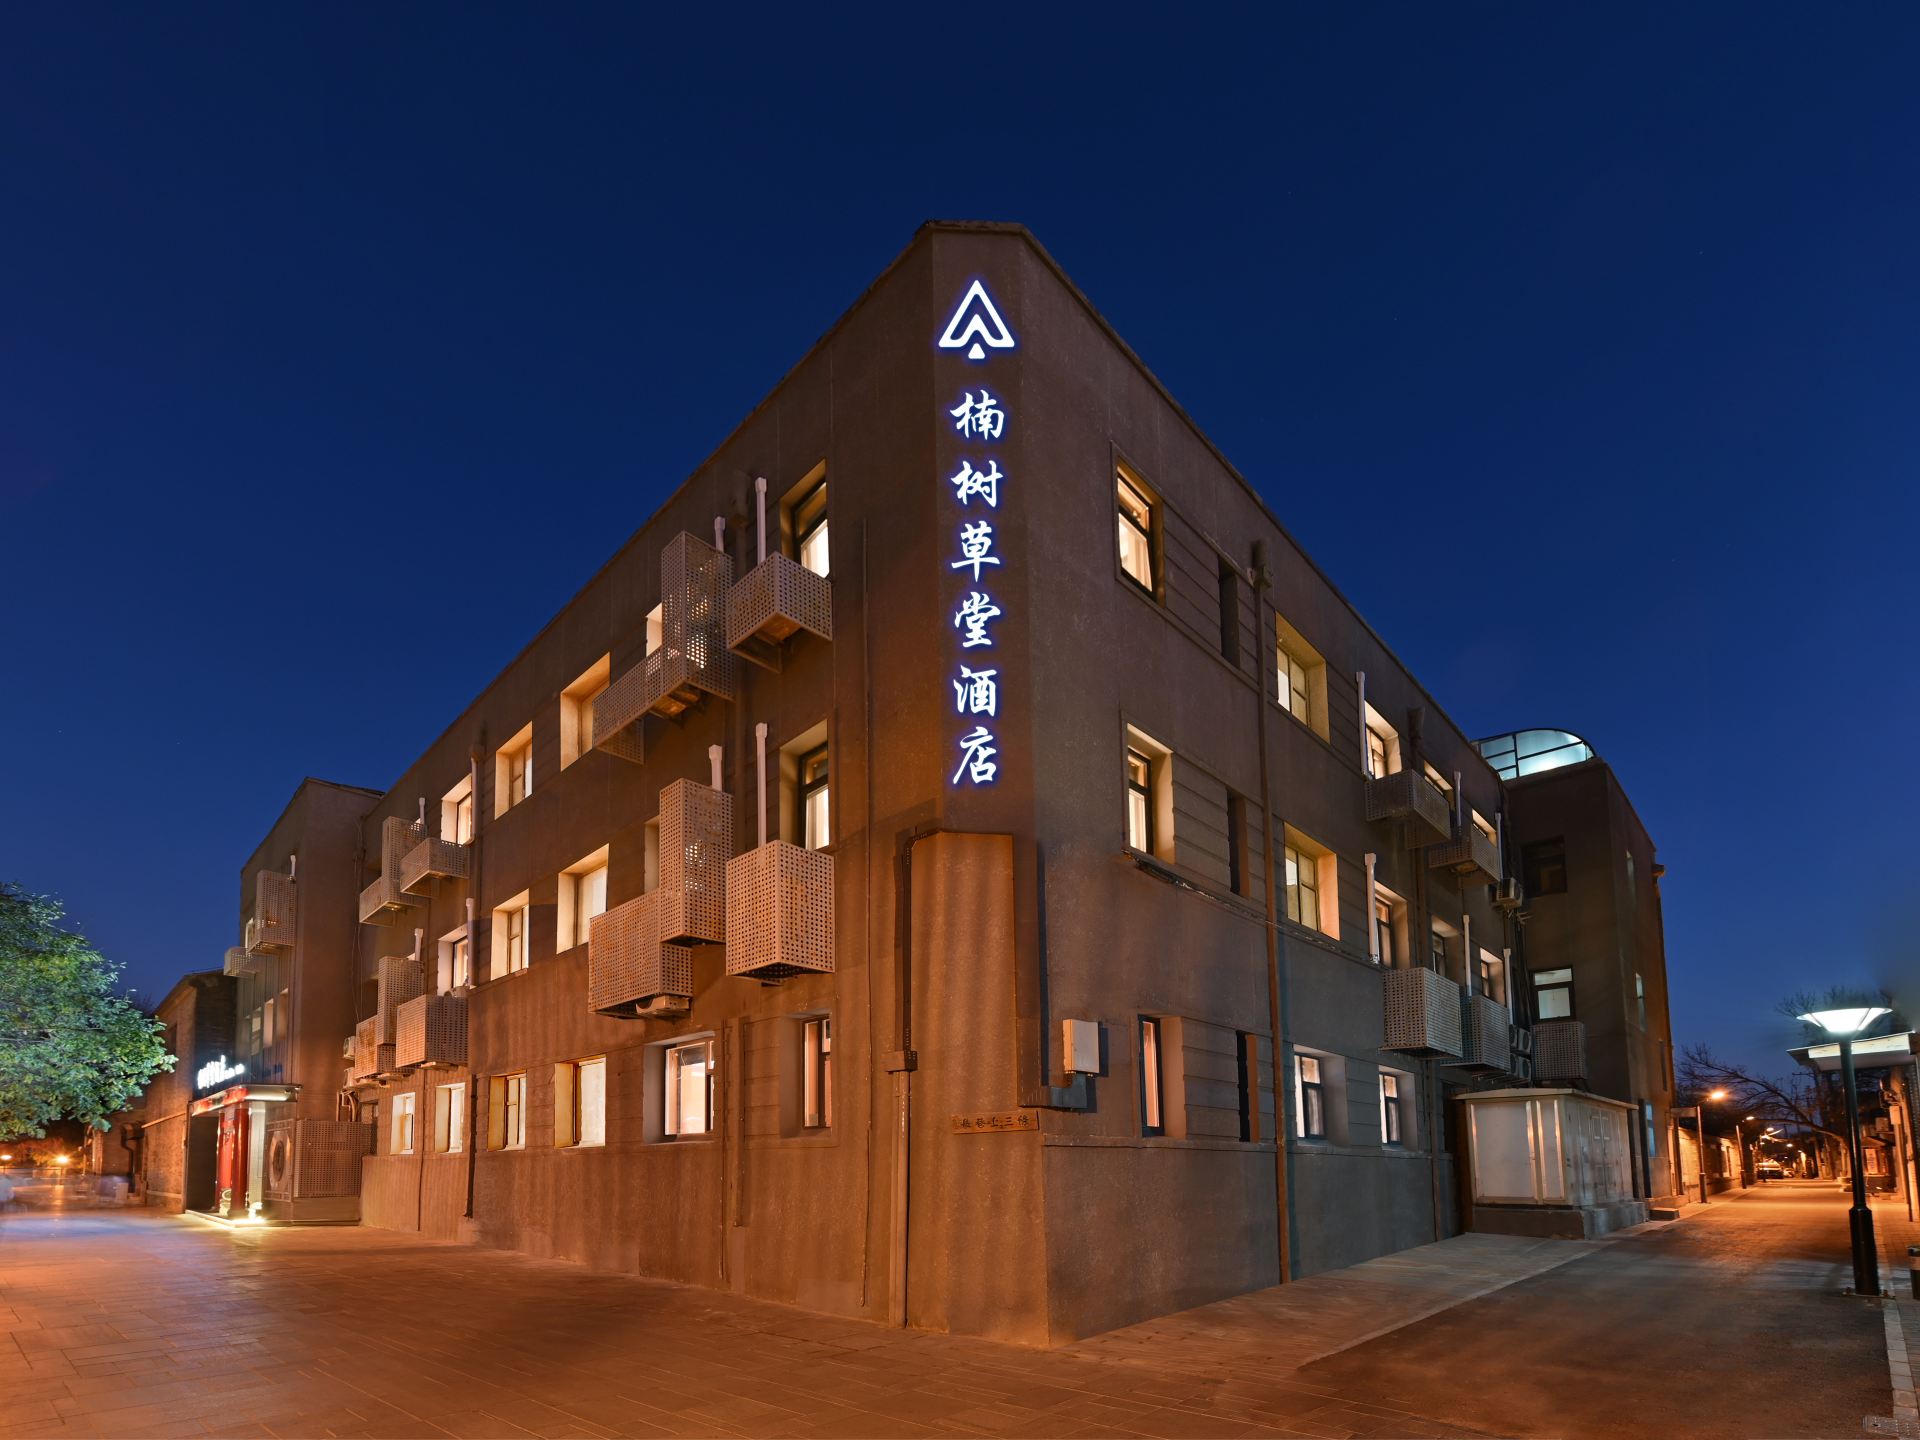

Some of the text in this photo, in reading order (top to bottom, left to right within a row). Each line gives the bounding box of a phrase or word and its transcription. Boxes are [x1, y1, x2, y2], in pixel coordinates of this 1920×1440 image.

[949, 389, 1005, 785] 楠树草堂酒店
